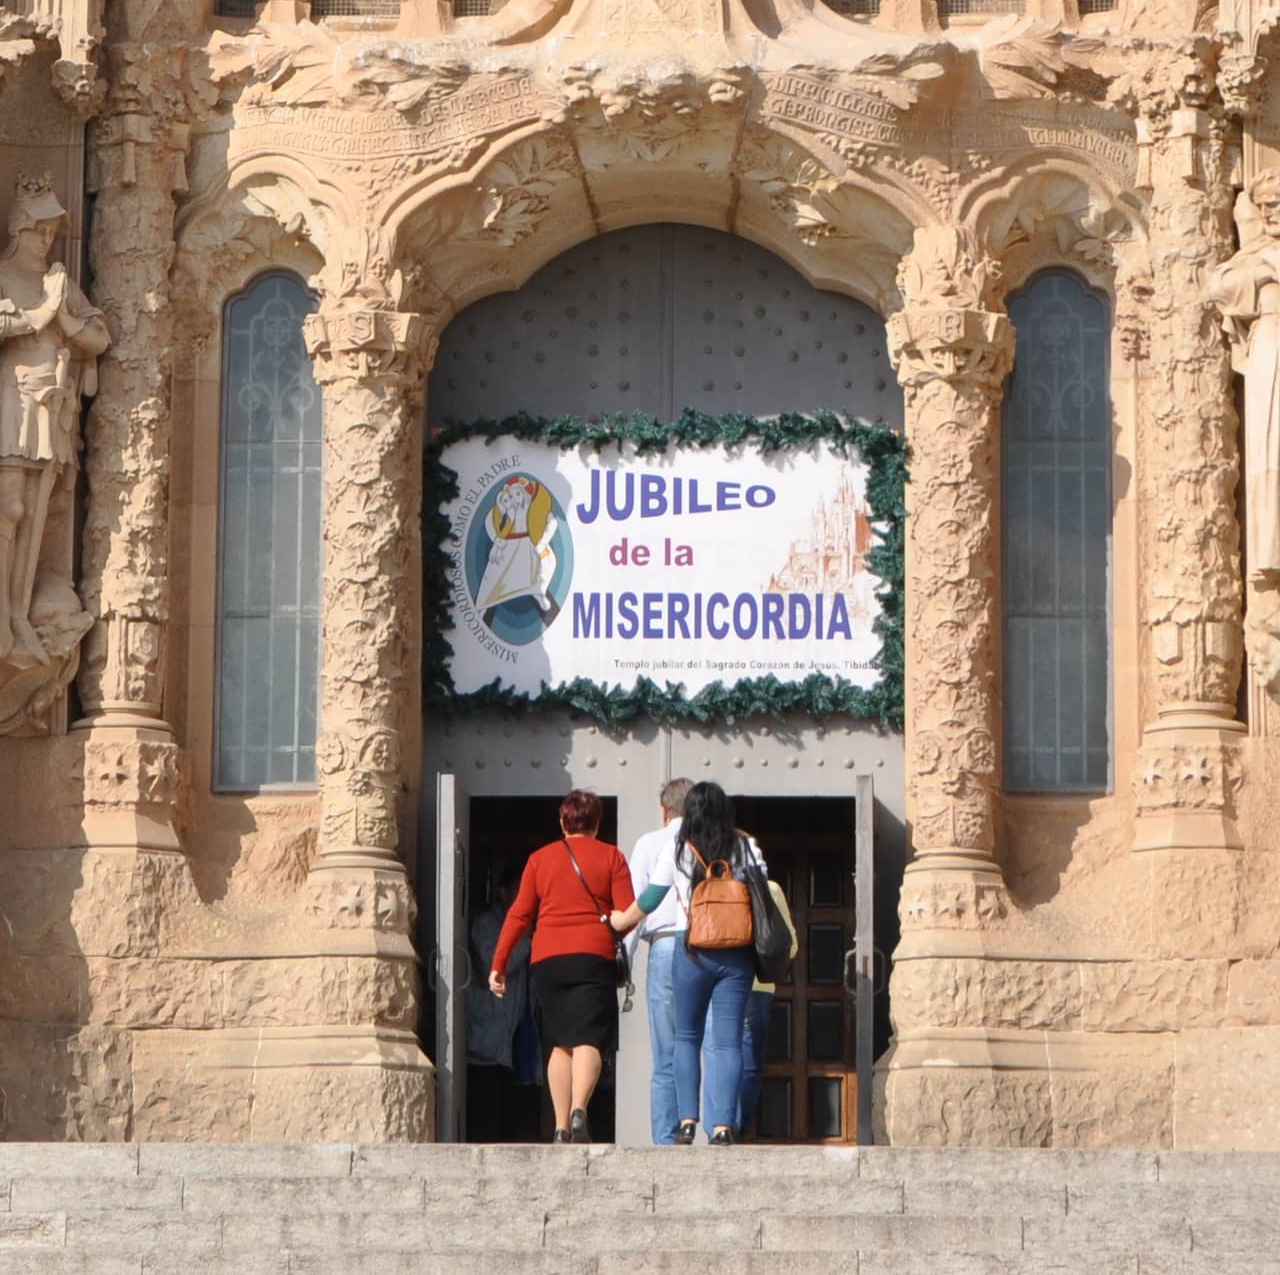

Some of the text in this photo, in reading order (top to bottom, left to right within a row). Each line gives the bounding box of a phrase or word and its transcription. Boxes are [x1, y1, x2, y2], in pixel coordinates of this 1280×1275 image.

[576, 468, 776, 524] JUBILEO
[450, 454, 521, 664] MISERICORDIOSOS COMO EL PADRE
[609, 538, 693, 566] de la
[572, 592, 852, 640] MISERICORDIA
[614, 659, 650, 670] Templo
[652, 659, 684, 670] jubilar
[687, 660, 702, 668] del
[705, 660, 747, 671] Sagrado
[793, 660, 805, 669] de
